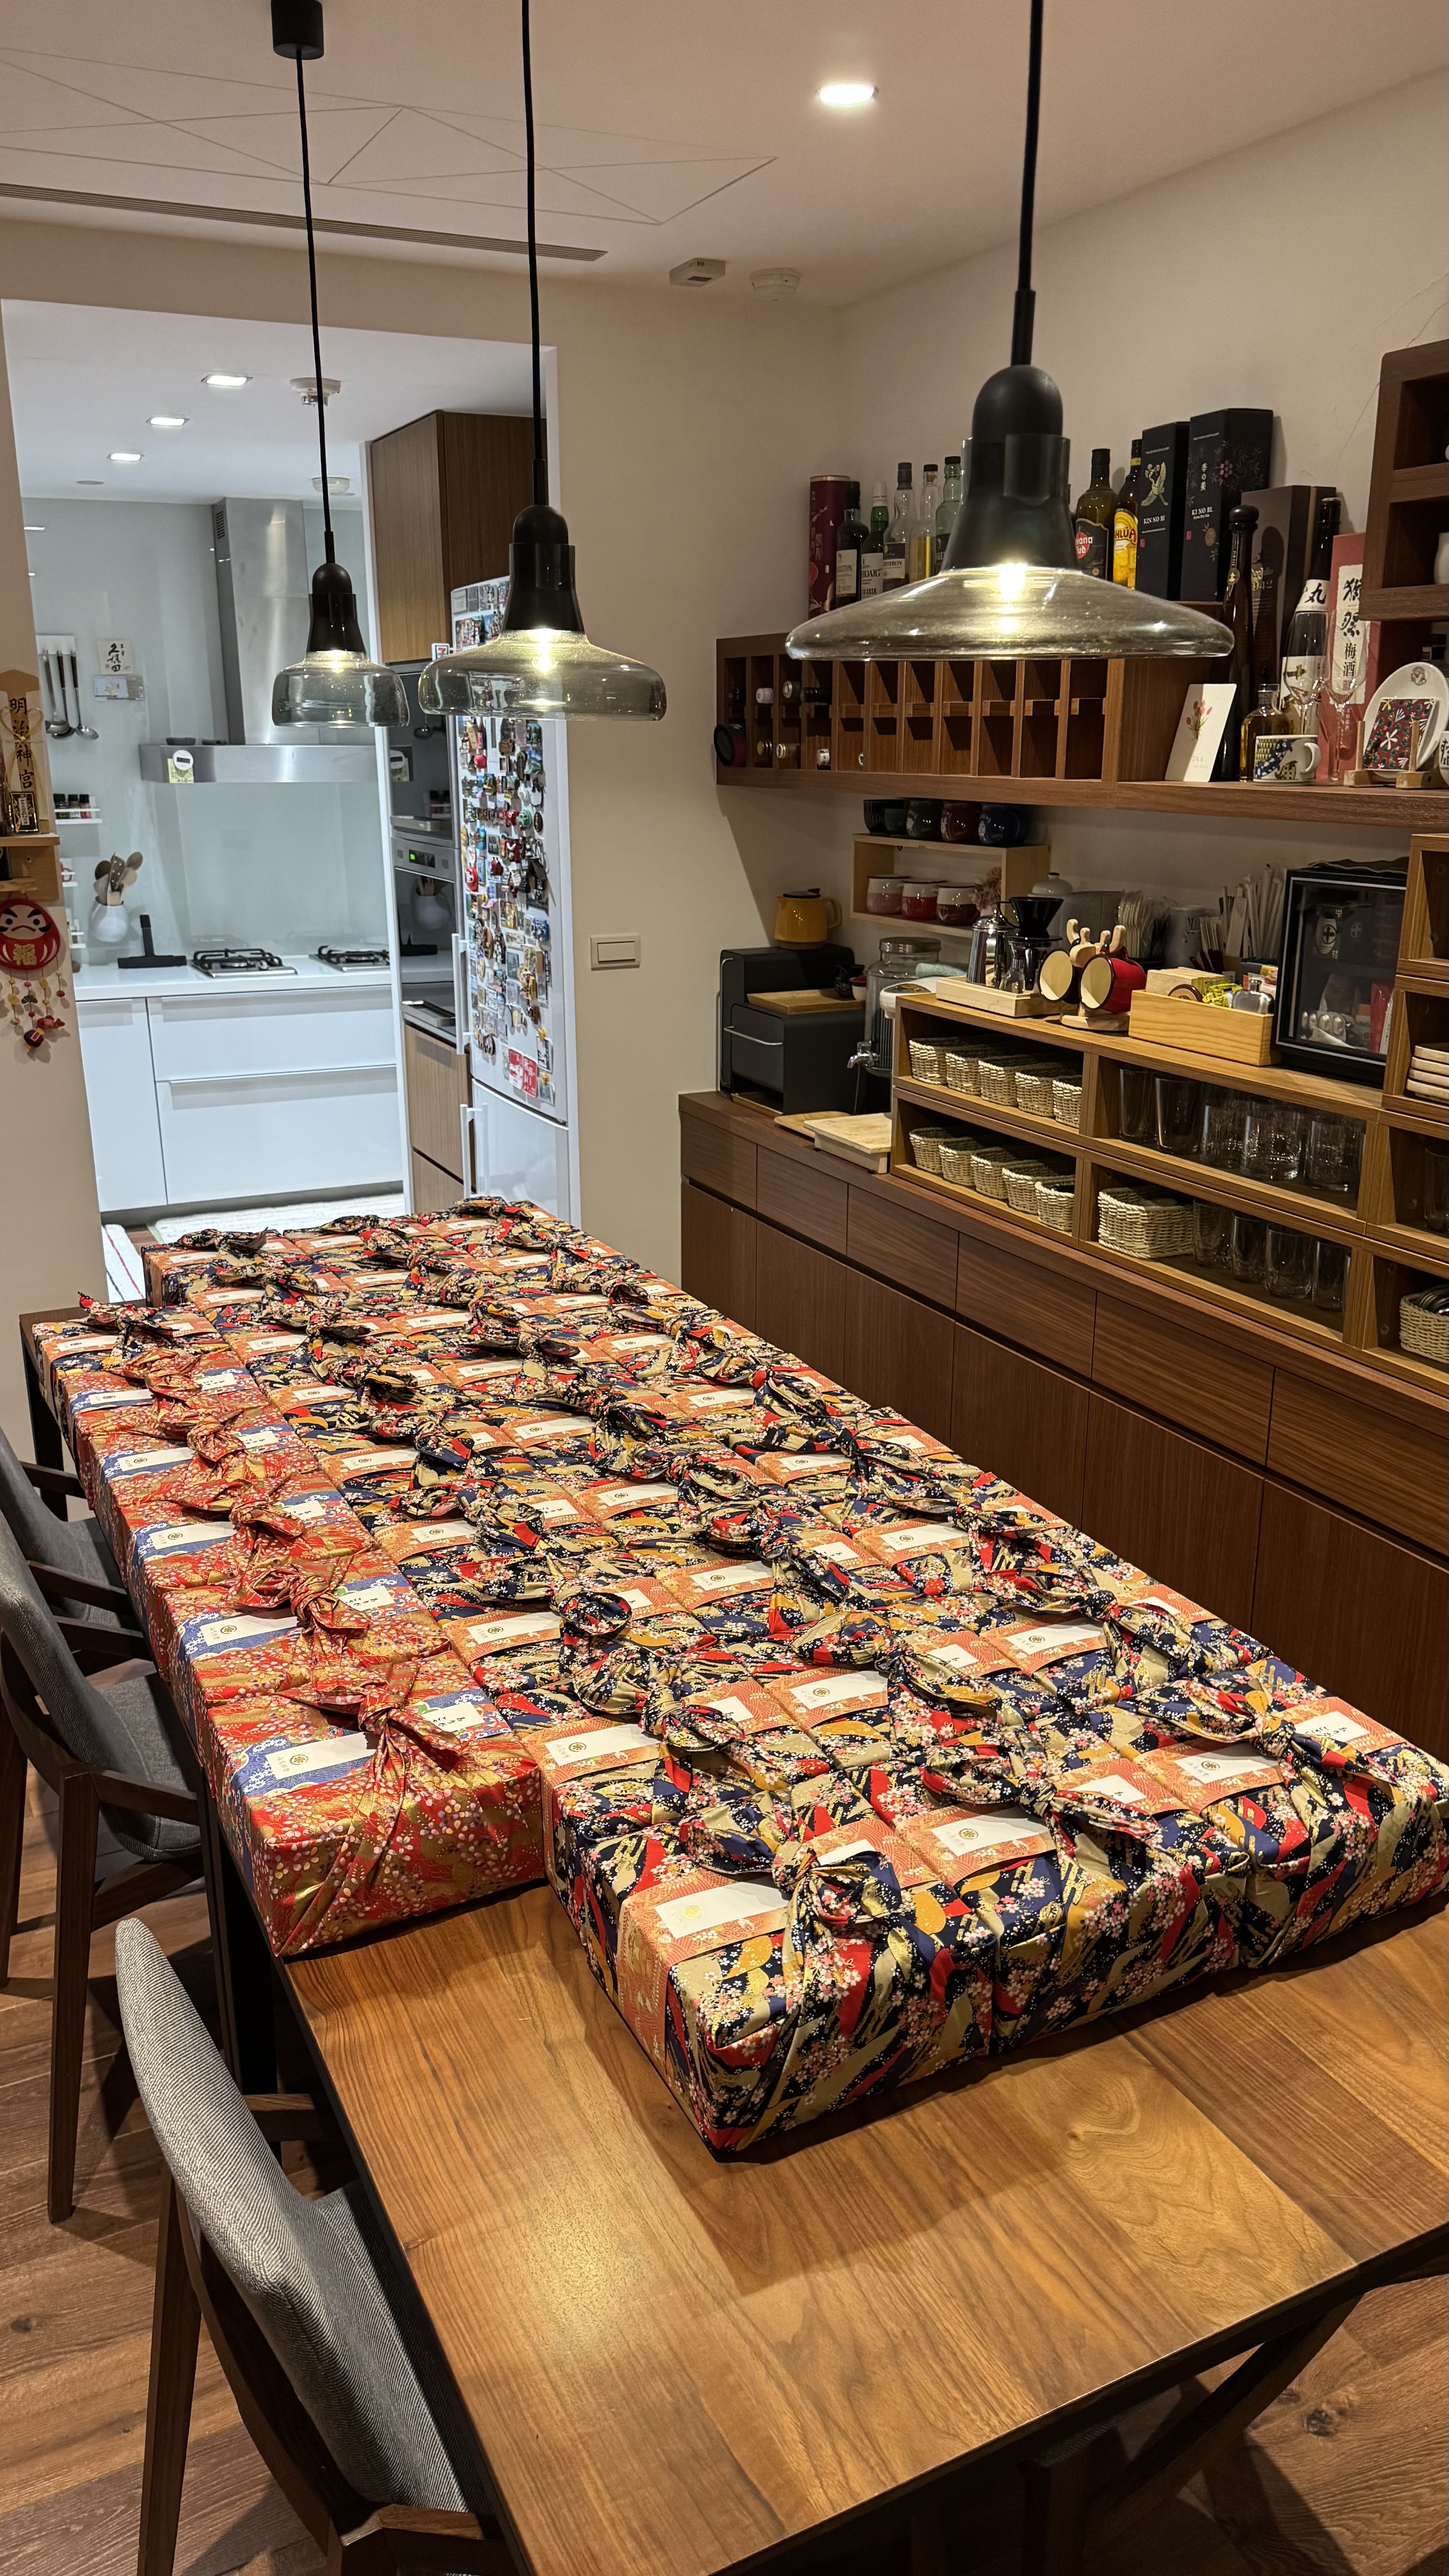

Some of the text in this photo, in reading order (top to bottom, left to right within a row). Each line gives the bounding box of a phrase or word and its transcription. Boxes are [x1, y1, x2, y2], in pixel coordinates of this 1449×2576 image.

[1075, 536, 1093, 544] vana
[1115, 527, 1137, 544] HLÚA
[1076, 546, 1086, 554] lub
[1303, 583, 1326, 604] 丸
[1343, 642, 1357, 677] 梅酒
